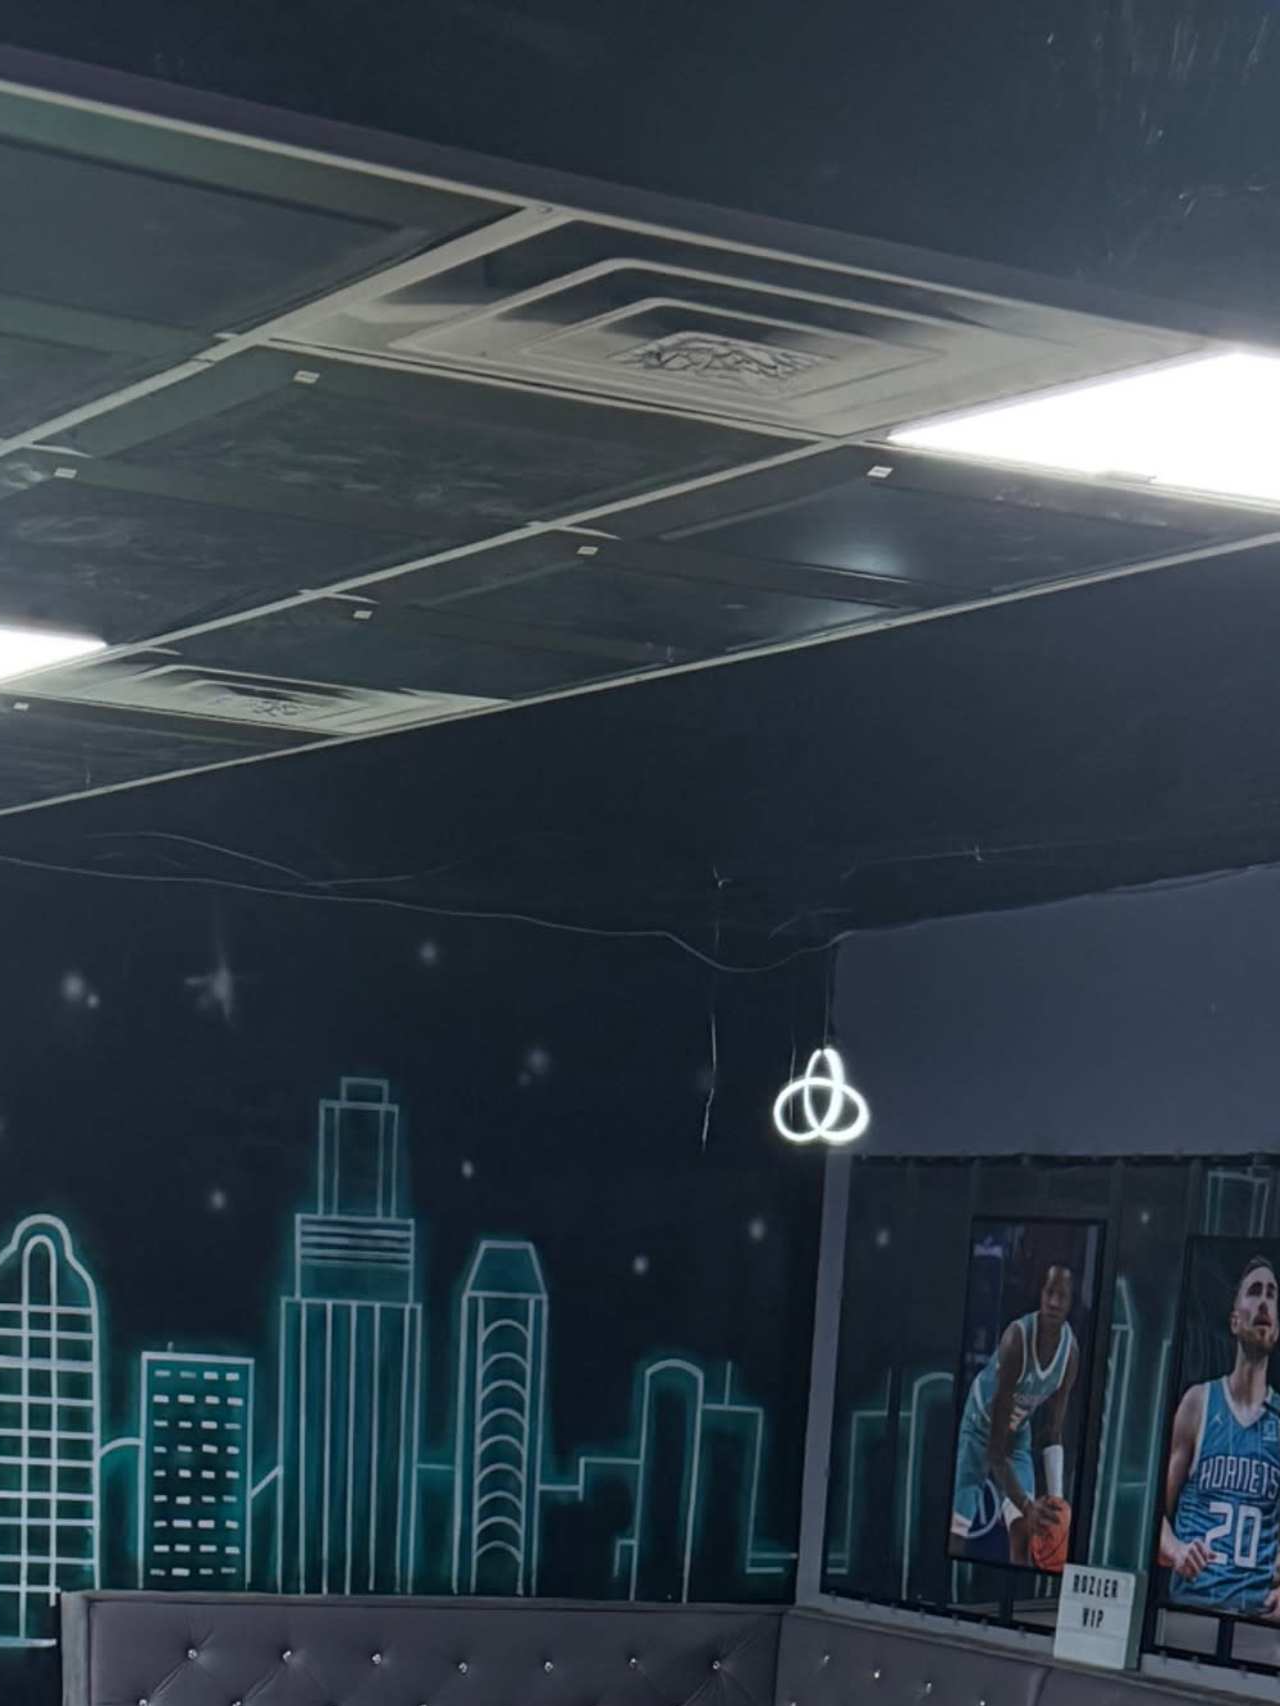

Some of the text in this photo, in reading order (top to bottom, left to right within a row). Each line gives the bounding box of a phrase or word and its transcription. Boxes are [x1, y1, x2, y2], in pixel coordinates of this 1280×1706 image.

[1199, 1455, 1280, 1499] HORNETS
[1205, 1501, 1262, 1568] 20
[1073, 1574, 1118, 1598] ROZIER
[1083, 1607, 1104, 1628] VIP
